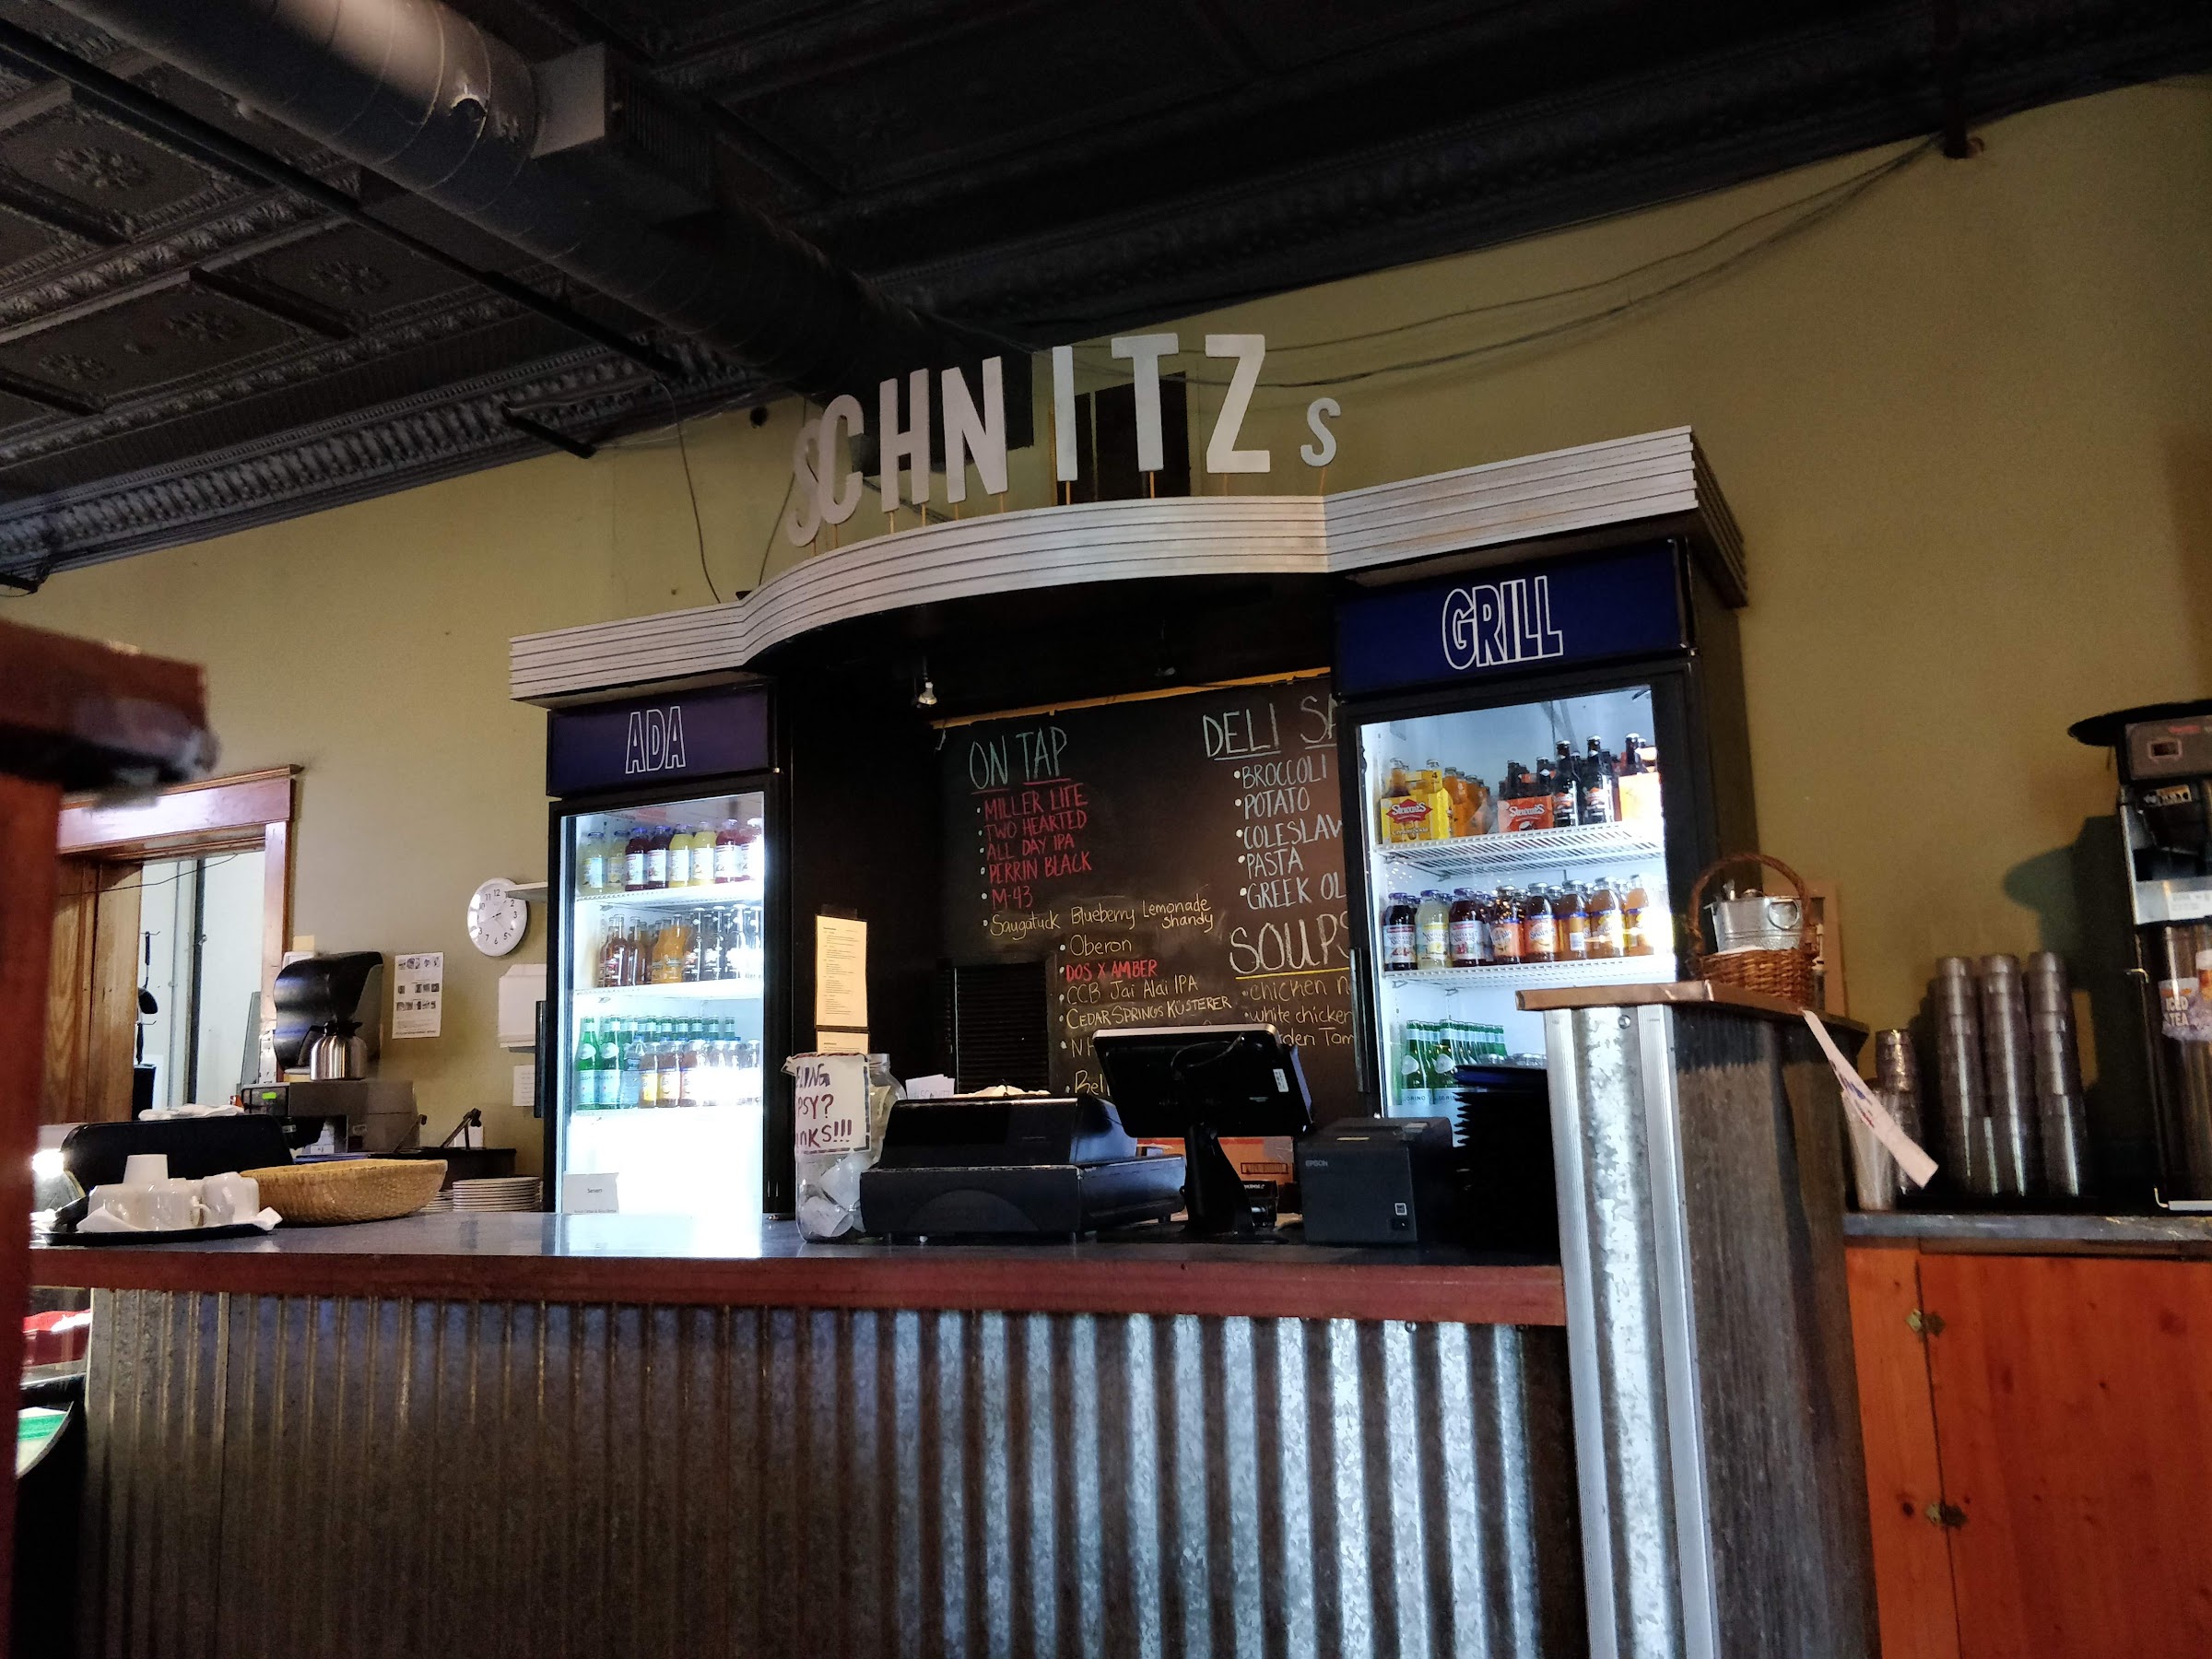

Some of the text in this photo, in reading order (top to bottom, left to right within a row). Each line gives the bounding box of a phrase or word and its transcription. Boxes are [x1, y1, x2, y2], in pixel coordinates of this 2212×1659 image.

[1442, 575, 1563, 671] GRILL
[625, 706, 686, 774] ADA
[1203, 702, 1280, 758] DELI
[970, 726, 1067, 790] ON TAP
[1242, 754, 1327, 789] BROCCOLI
[984, 782, 1088, 821] MILLER LITE
[1244, 786, 1311, 819] POTATO
[984, 810, 1088, 841] TWO HEARTED
[987, 832, 1075, 861] ALL DAY IPA
[1246, 846, 1304, 879] PASTA
[989, 851, 1092, 885] PERRIN BLACK
[493, 888, 500, 897] 12
[991, 886, 1033, 911] M-43
[1247, 877, 1312, 910] GREEK
[990, 893, 1211, 940] Saugatuck Blueberry Lemonade
[1161, 912, 1214, 933] shandy
[1070, 934, 1132, 956] Oberon
[1066, 959, 1158, 982] DOS X AMBER
[1066, 974, 1198, 1006] CCB Jai Alai IPA
[1250, 978, 1327, 1002] chicken
[1066, 1008, 1112, 1030] CEDAR
[1250, 1005, 1290, 1023] white
[2170, 1012, 2189, 1027] TEA
